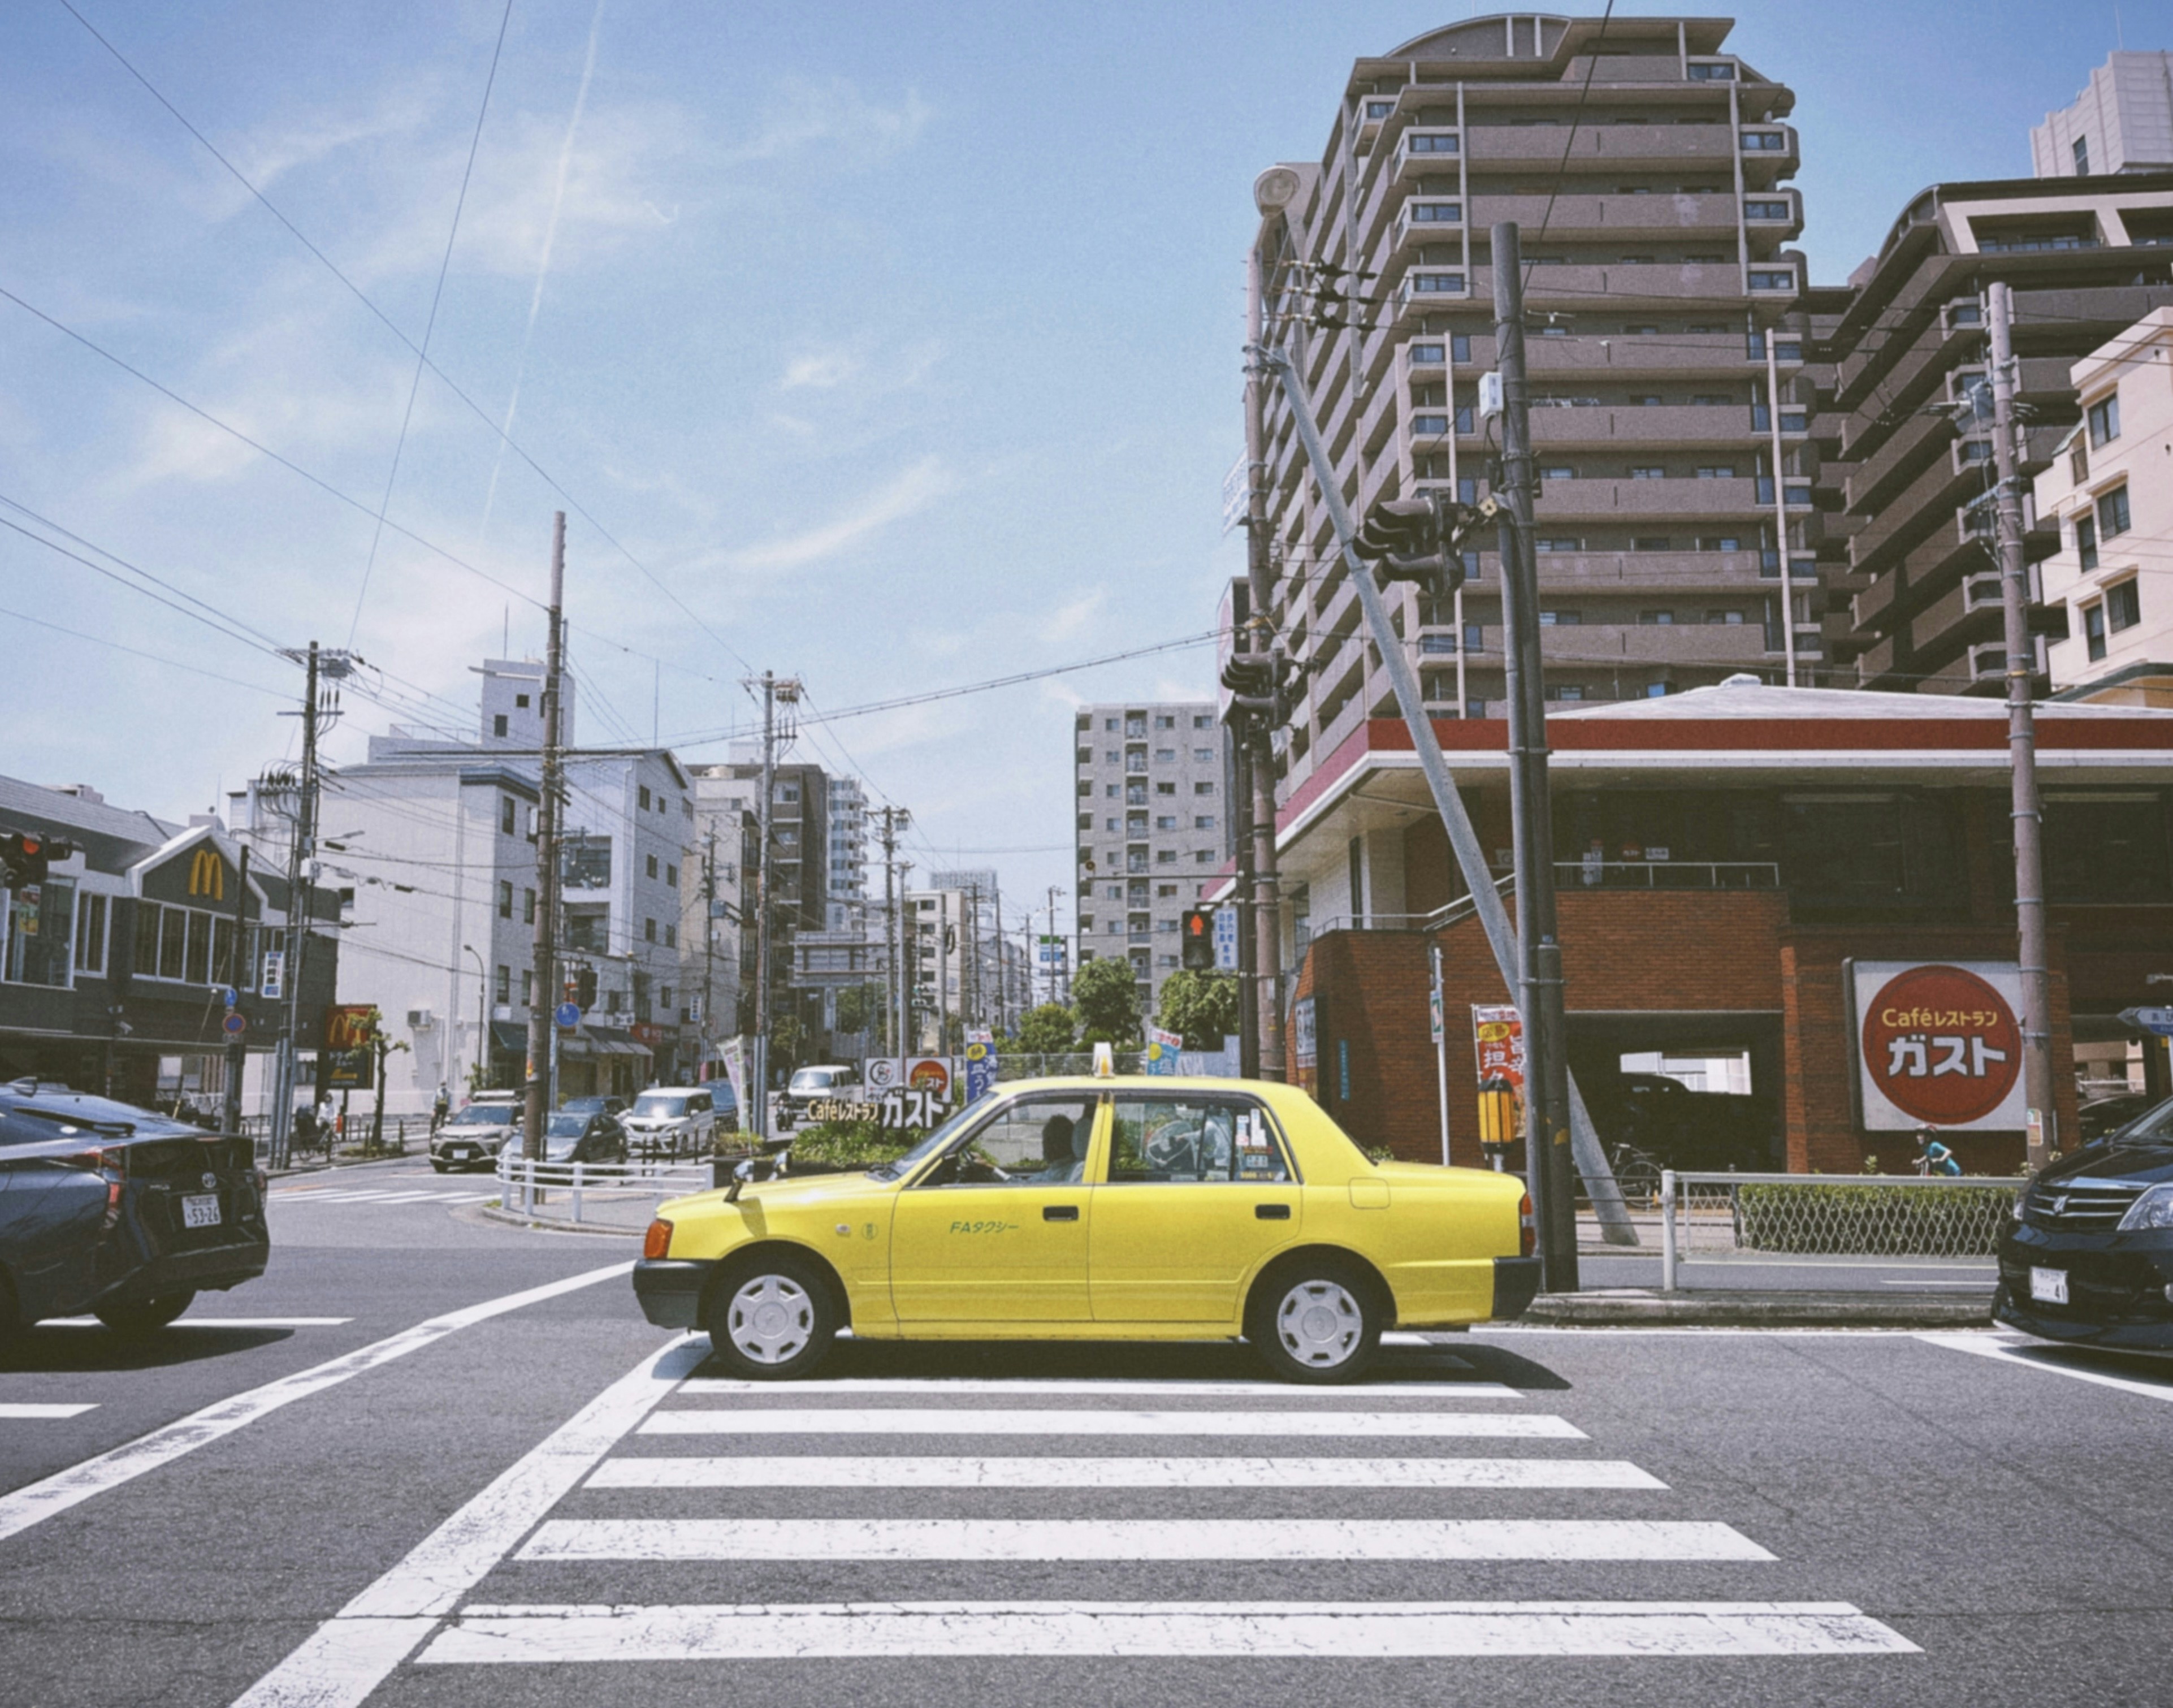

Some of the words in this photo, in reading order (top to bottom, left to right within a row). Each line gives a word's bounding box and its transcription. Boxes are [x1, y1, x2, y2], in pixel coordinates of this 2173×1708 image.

[1882, 1007, 1998, 1027] Caféレストラン
[1888, 1034, 2006, 1076] ガスト
[807, 1099, 878, 1121] Caféレストラン
[882, 1089, 943, 1128] ガスト
[950, 1221, 1019, 1233] FAタクシー
